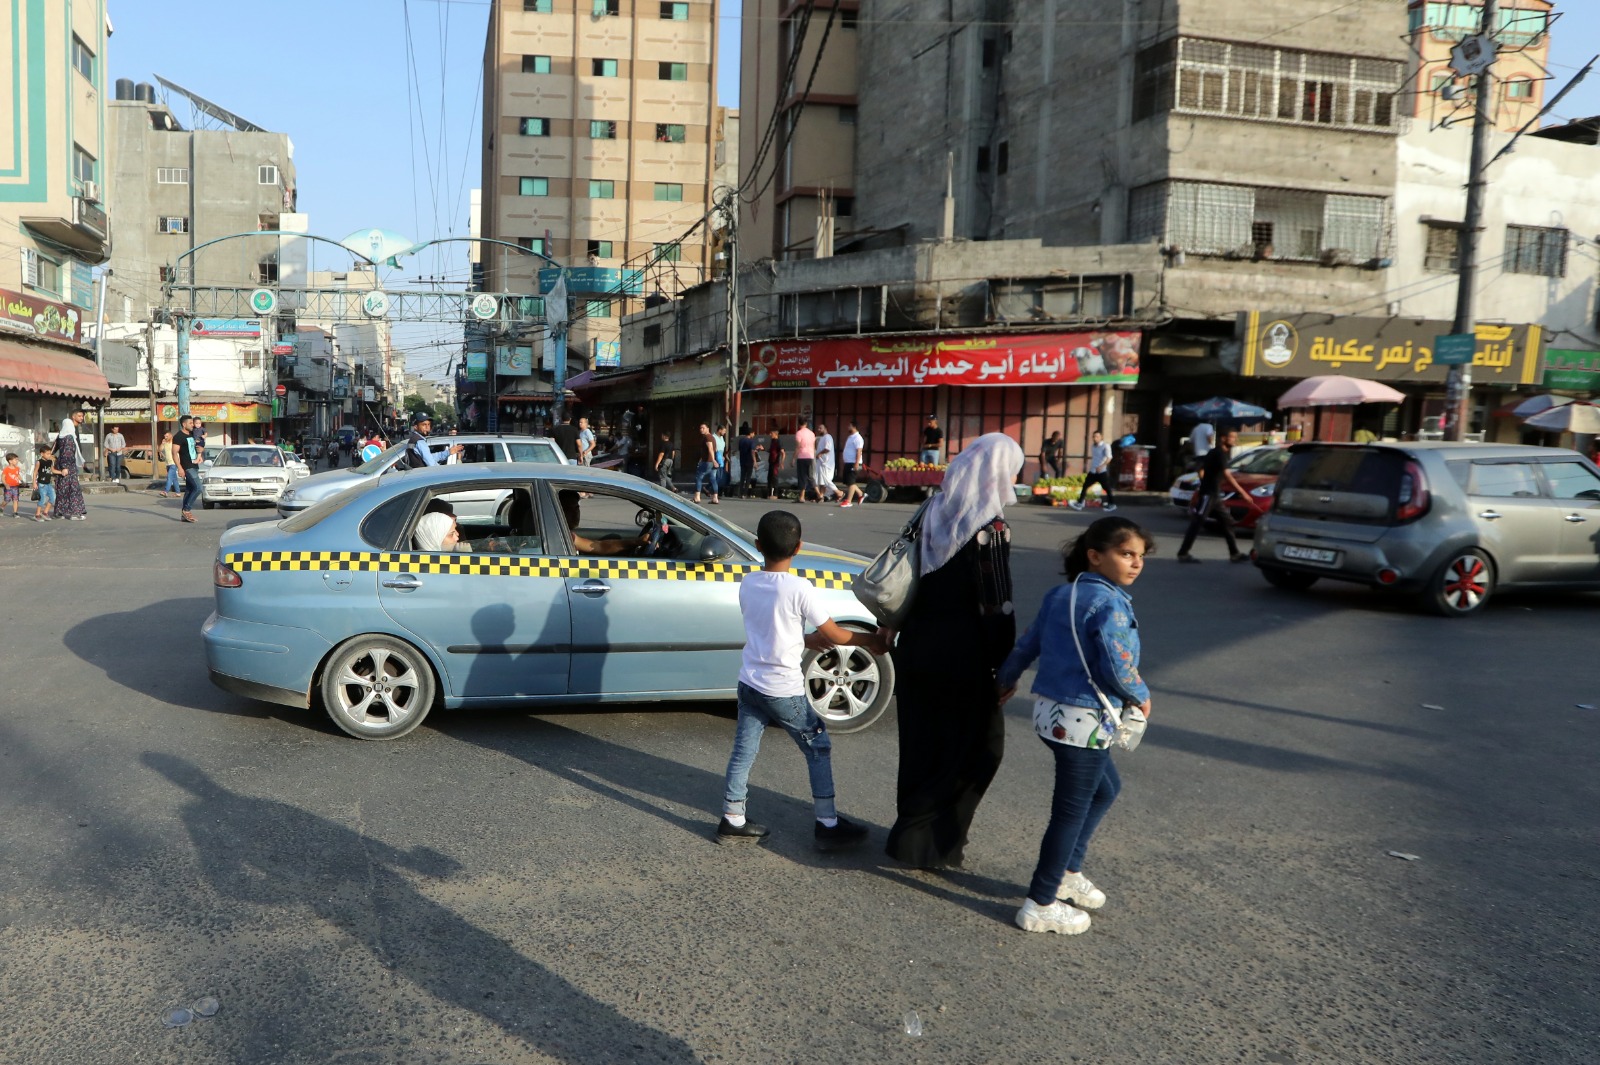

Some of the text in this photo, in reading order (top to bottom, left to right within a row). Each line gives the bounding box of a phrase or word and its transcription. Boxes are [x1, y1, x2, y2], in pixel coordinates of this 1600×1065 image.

[8, 299, 33, 318] مطعم
[936, 338, 997, 355] مطعم
[1309, 336, 1375, 368] عكيلة
[1374, 340, 1413, 371] نمر
[1470, 339, 1515, 373] أبناء
[816, 348, 1066, 386] أبناء أبو حمدي البحطيطي
